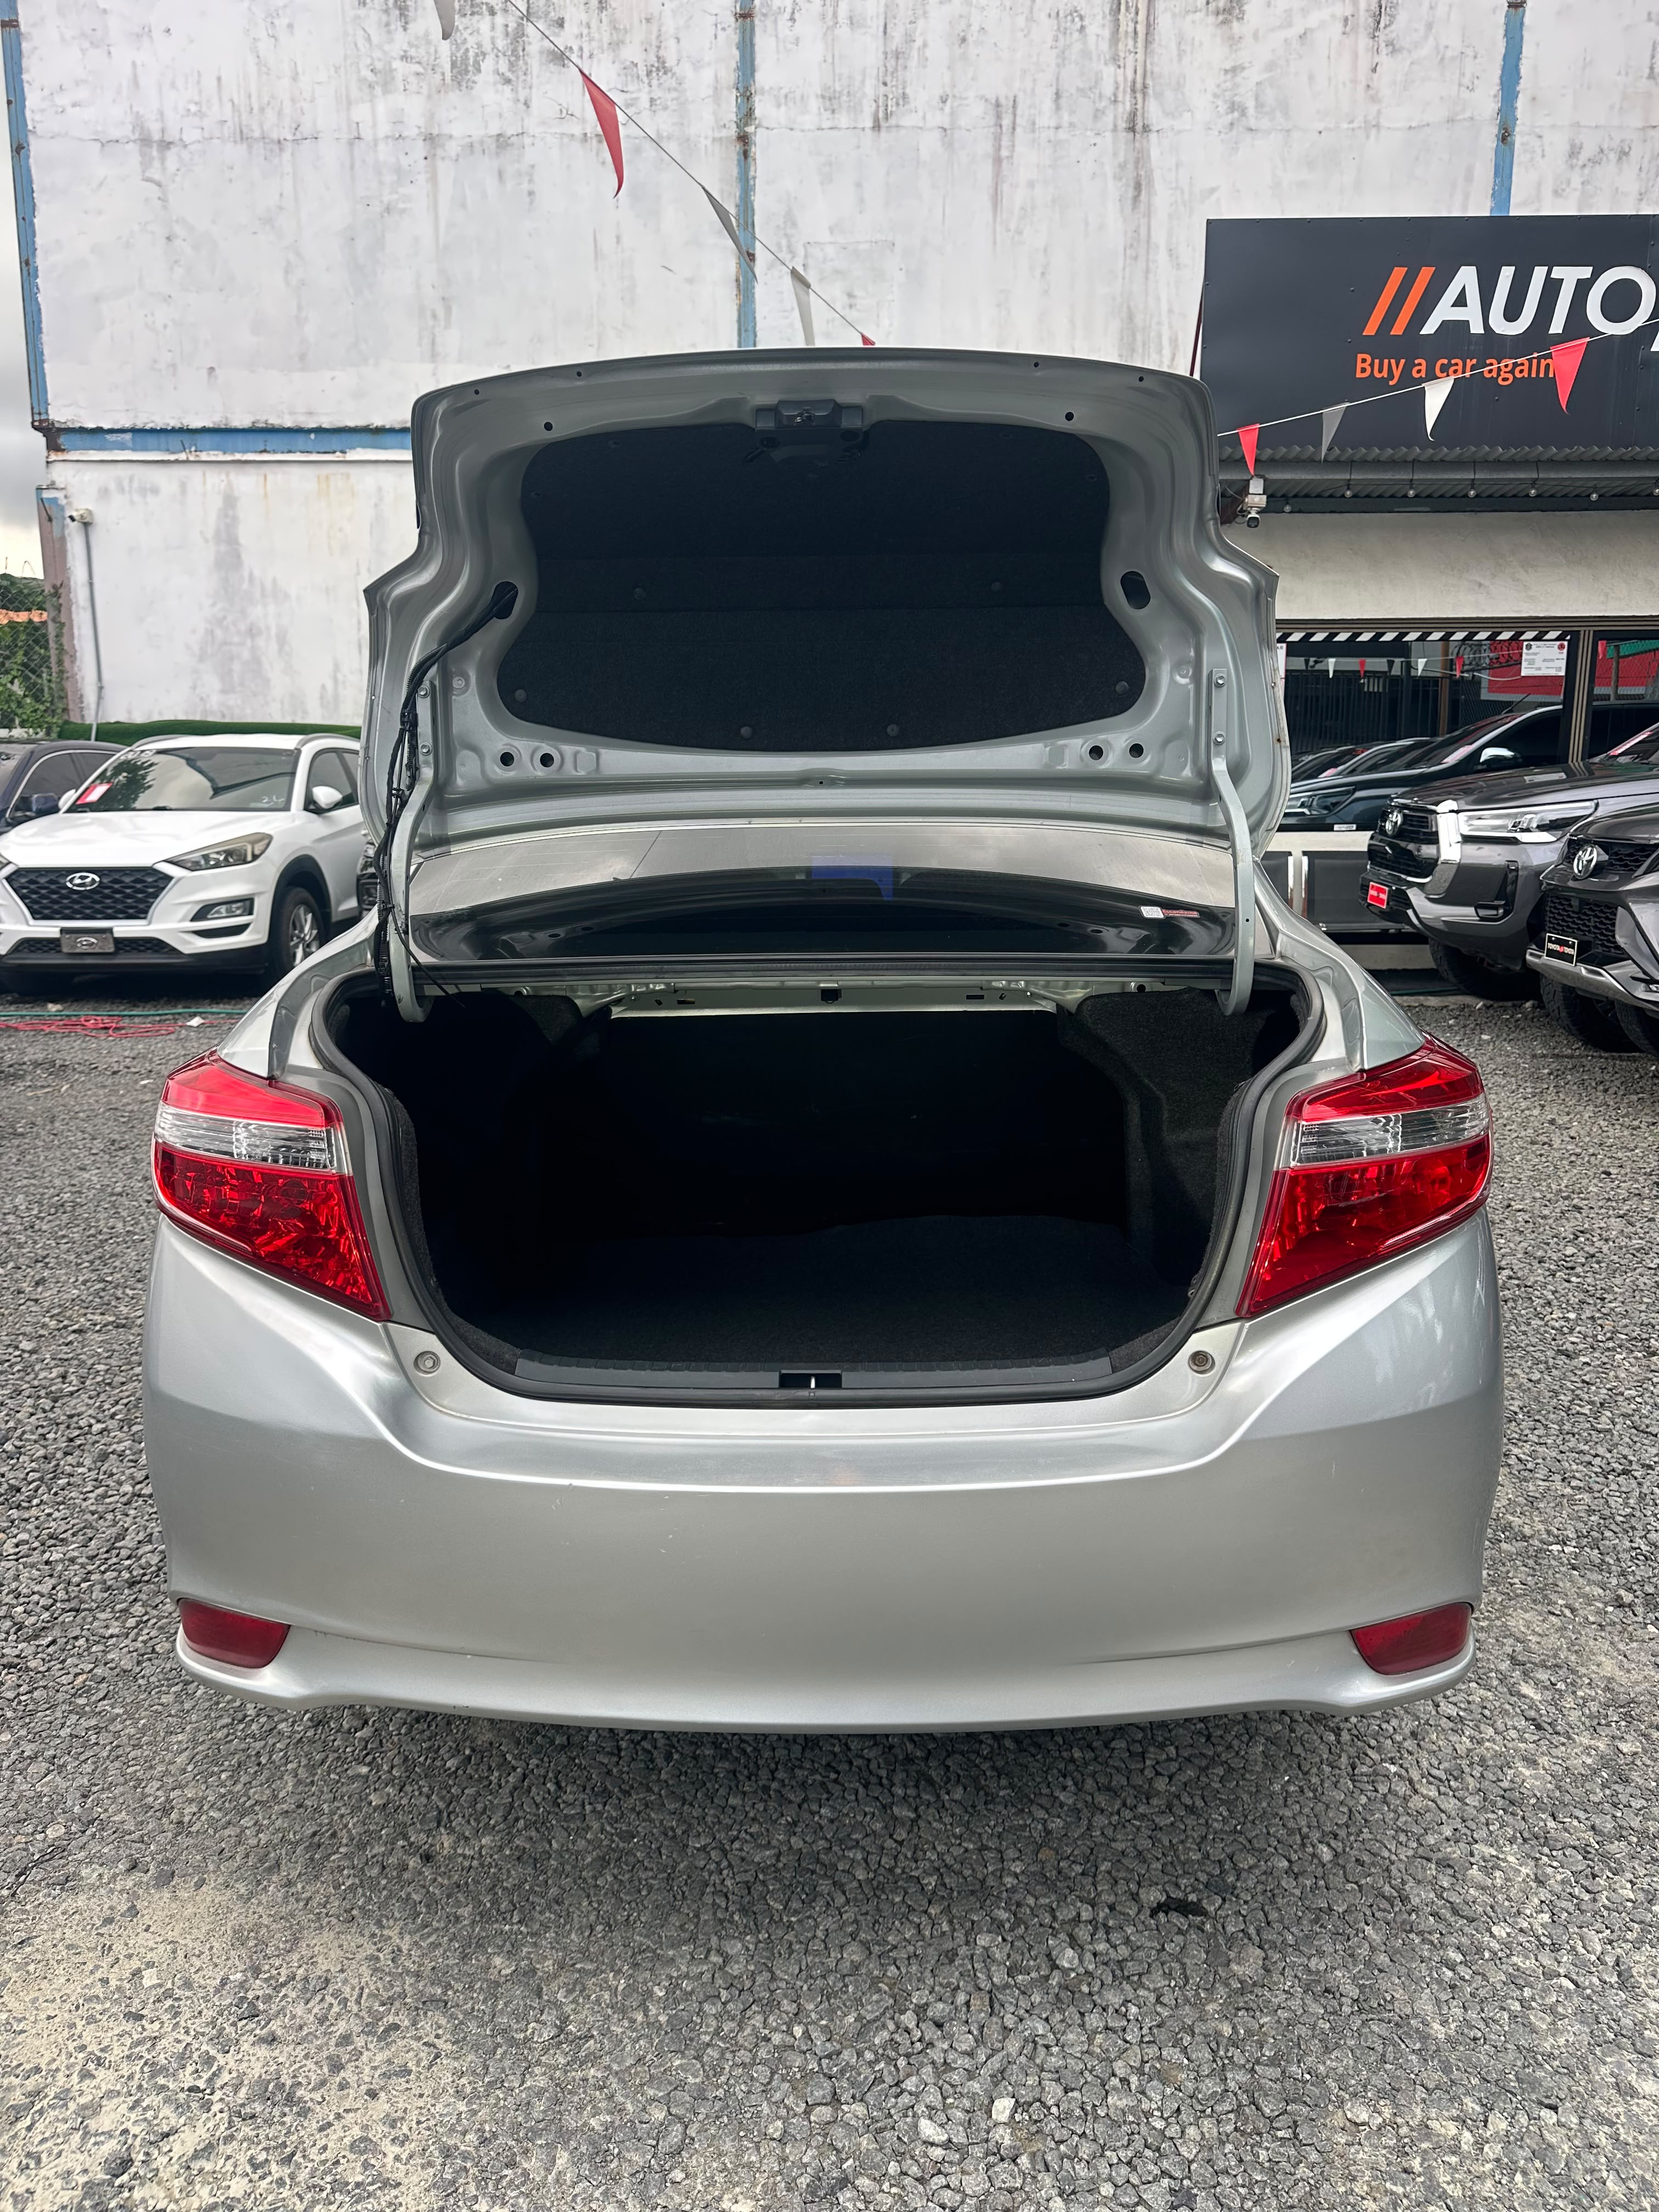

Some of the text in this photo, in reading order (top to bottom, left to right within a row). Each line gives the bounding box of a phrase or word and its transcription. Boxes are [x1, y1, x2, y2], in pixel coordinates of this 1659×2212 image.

[1419, 266, 1659, 352] AUTO
[1356, 352, 1555, 386] Buy a car again
